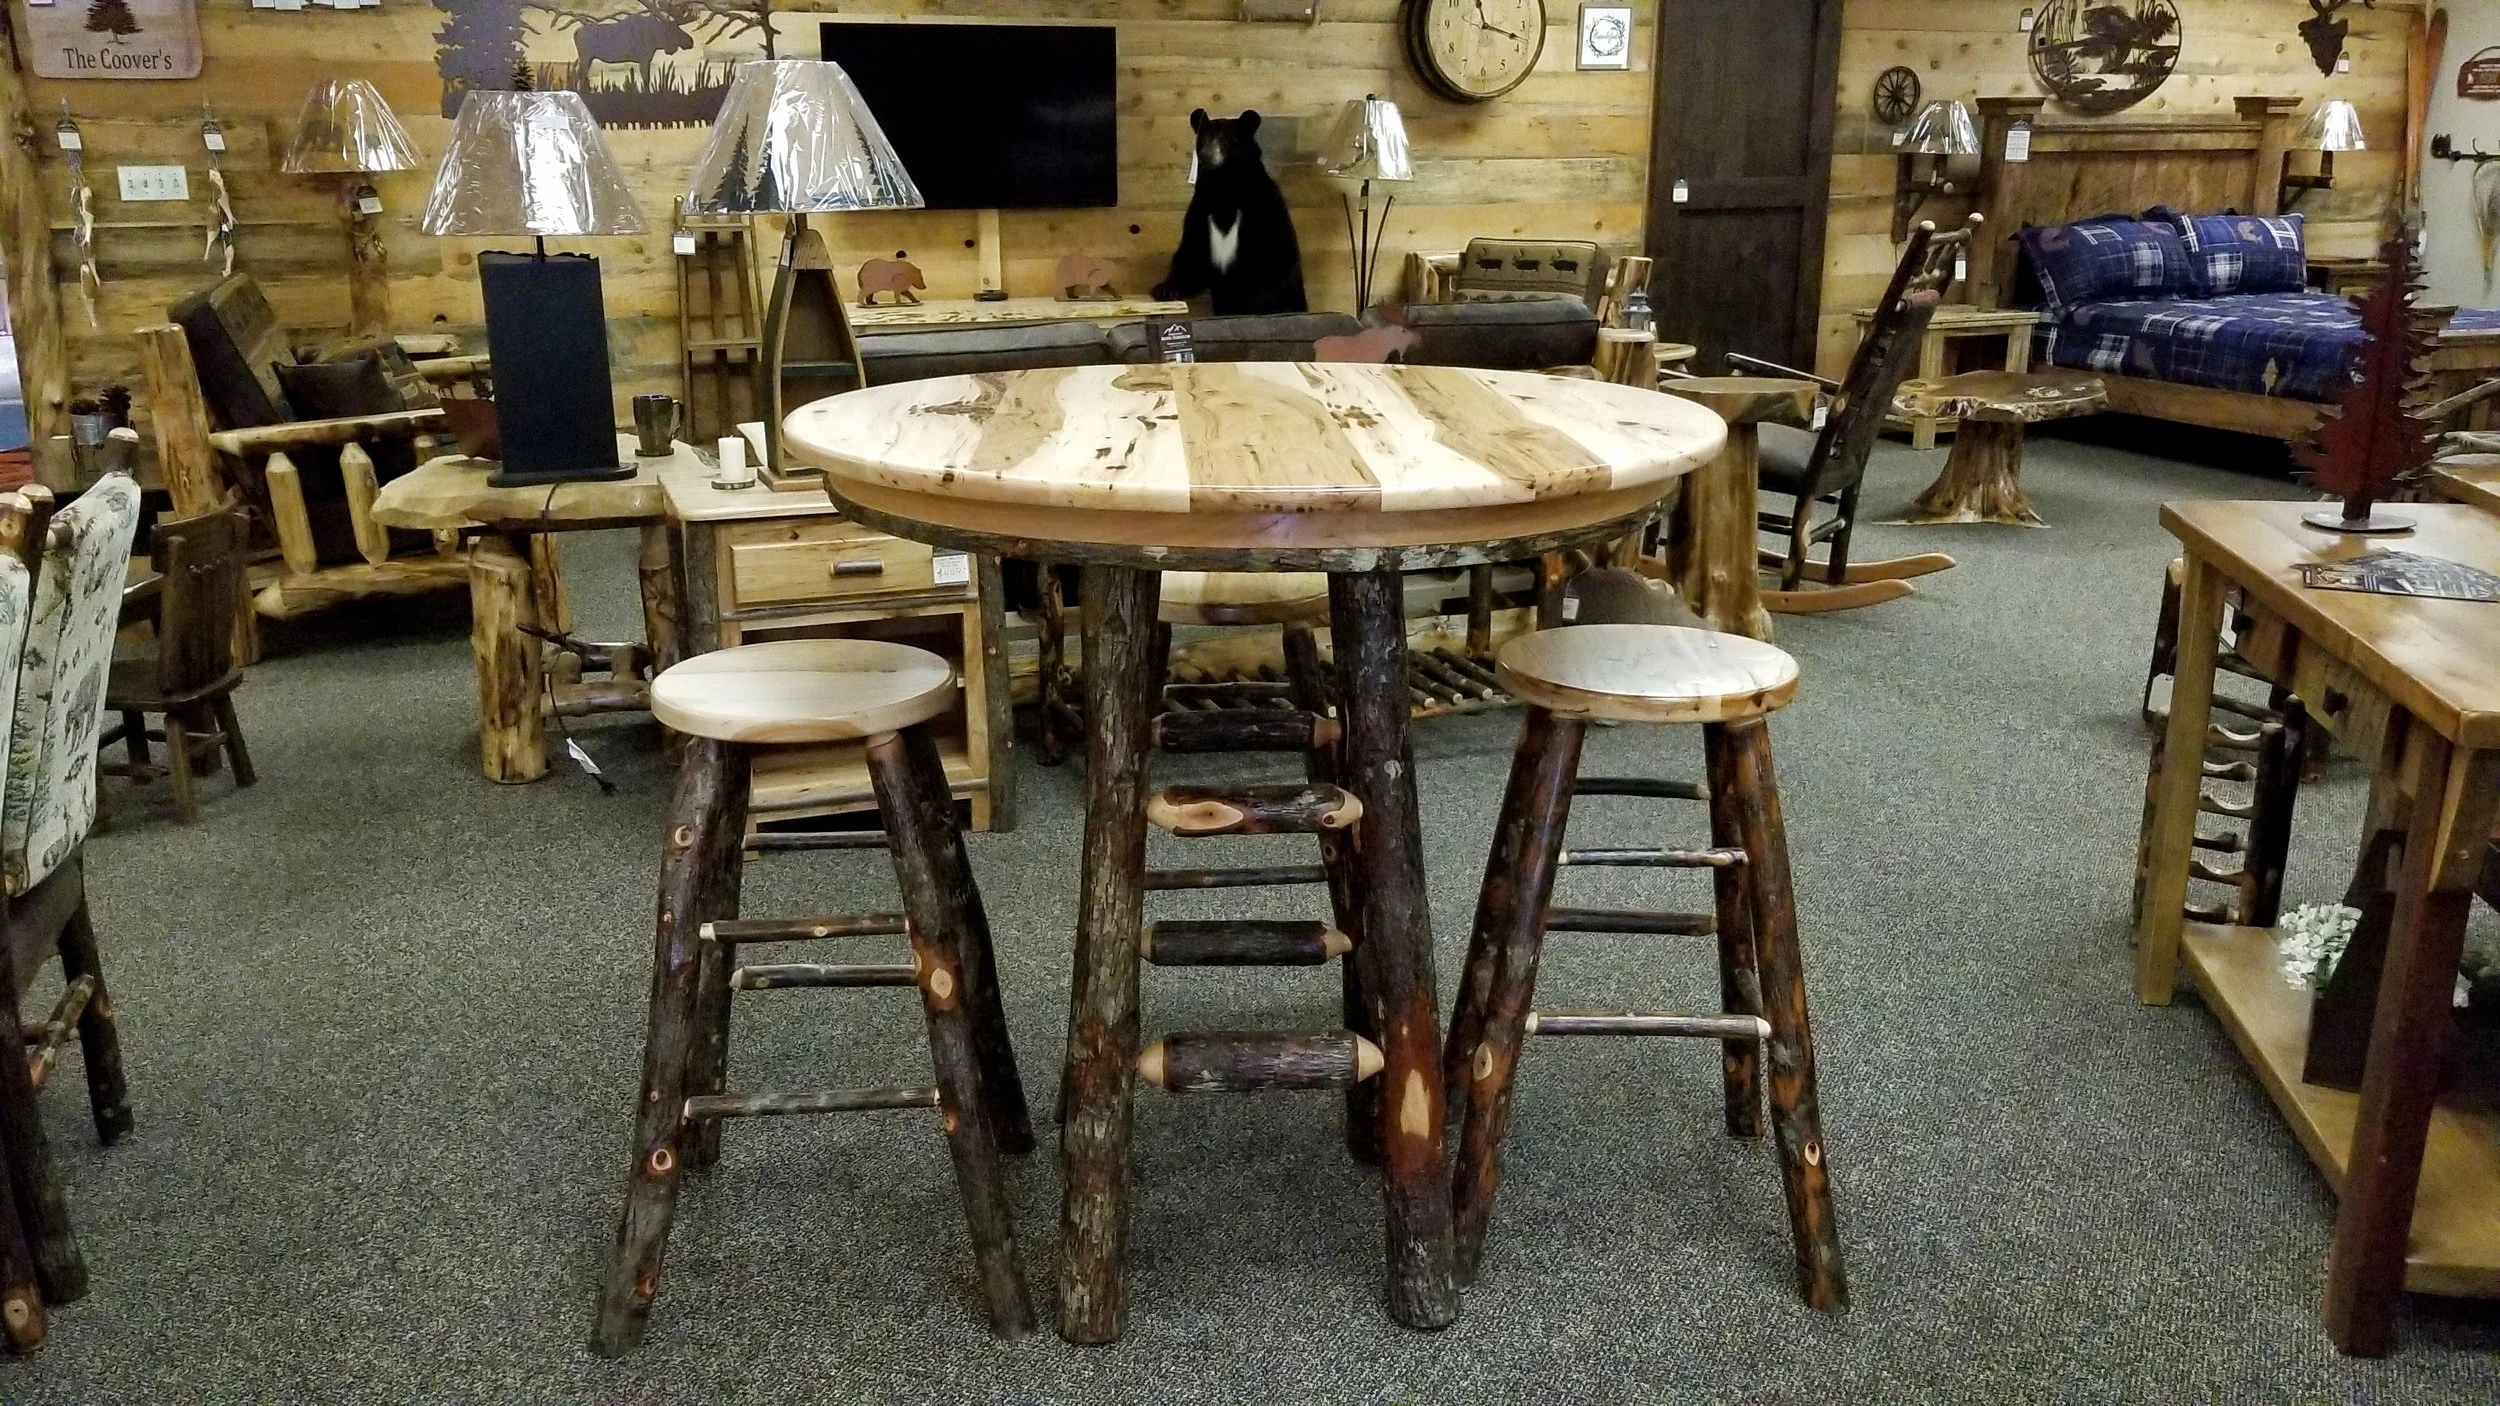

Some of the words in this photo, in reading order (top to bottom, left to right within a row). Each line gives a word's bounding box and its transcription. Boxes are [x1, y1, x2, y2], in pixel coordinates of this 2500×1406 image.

[1444, 19, 1451, 30] 9
[1519, 20, 1526, 32] 3
[1448, 41, 1455, 53] 8
[1513, 43, 1520, 54] 4
[62, 47, 96, 69] The
[100, 48, 173, 70] Coover's
[1499, 58, 1507, 71] 5
[1462, 59, 1468, 71] 7
[1480, 65, 1487, 77] 6
